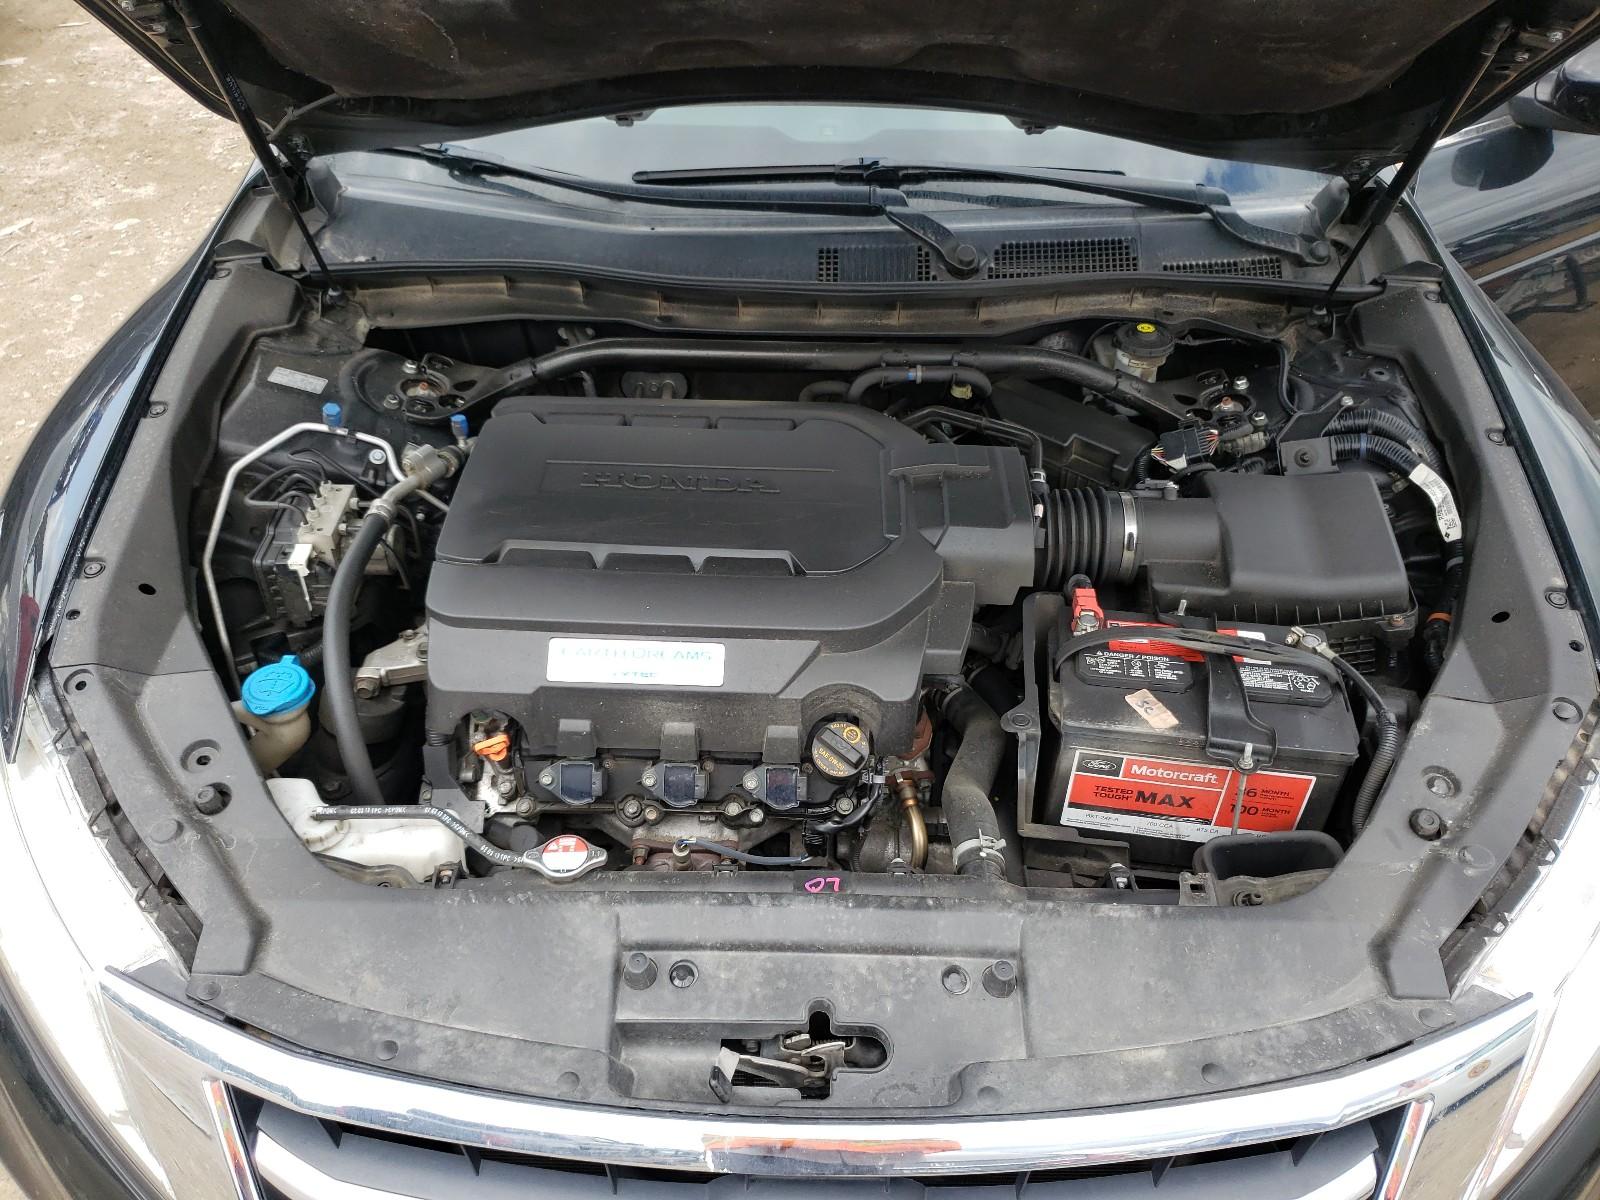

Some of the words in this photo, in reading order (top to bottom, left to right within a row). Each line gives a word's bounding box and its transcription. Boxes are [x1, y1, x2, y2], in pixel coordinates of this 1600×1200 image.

[580, 472, 781, 493] HONDA
[1103, 651, 1134, 659] DANGER
[1141, 654, 1170, 662] POISON
[1131, 764, 1218, 784] Motorcraft
[1094, 785, 1134, 795] TESTED
[1260, 788, 1291, 797] MONTH
[1134, 790, 1196, 809] MAX
[1261, 806, 1292, 815] MONTH
